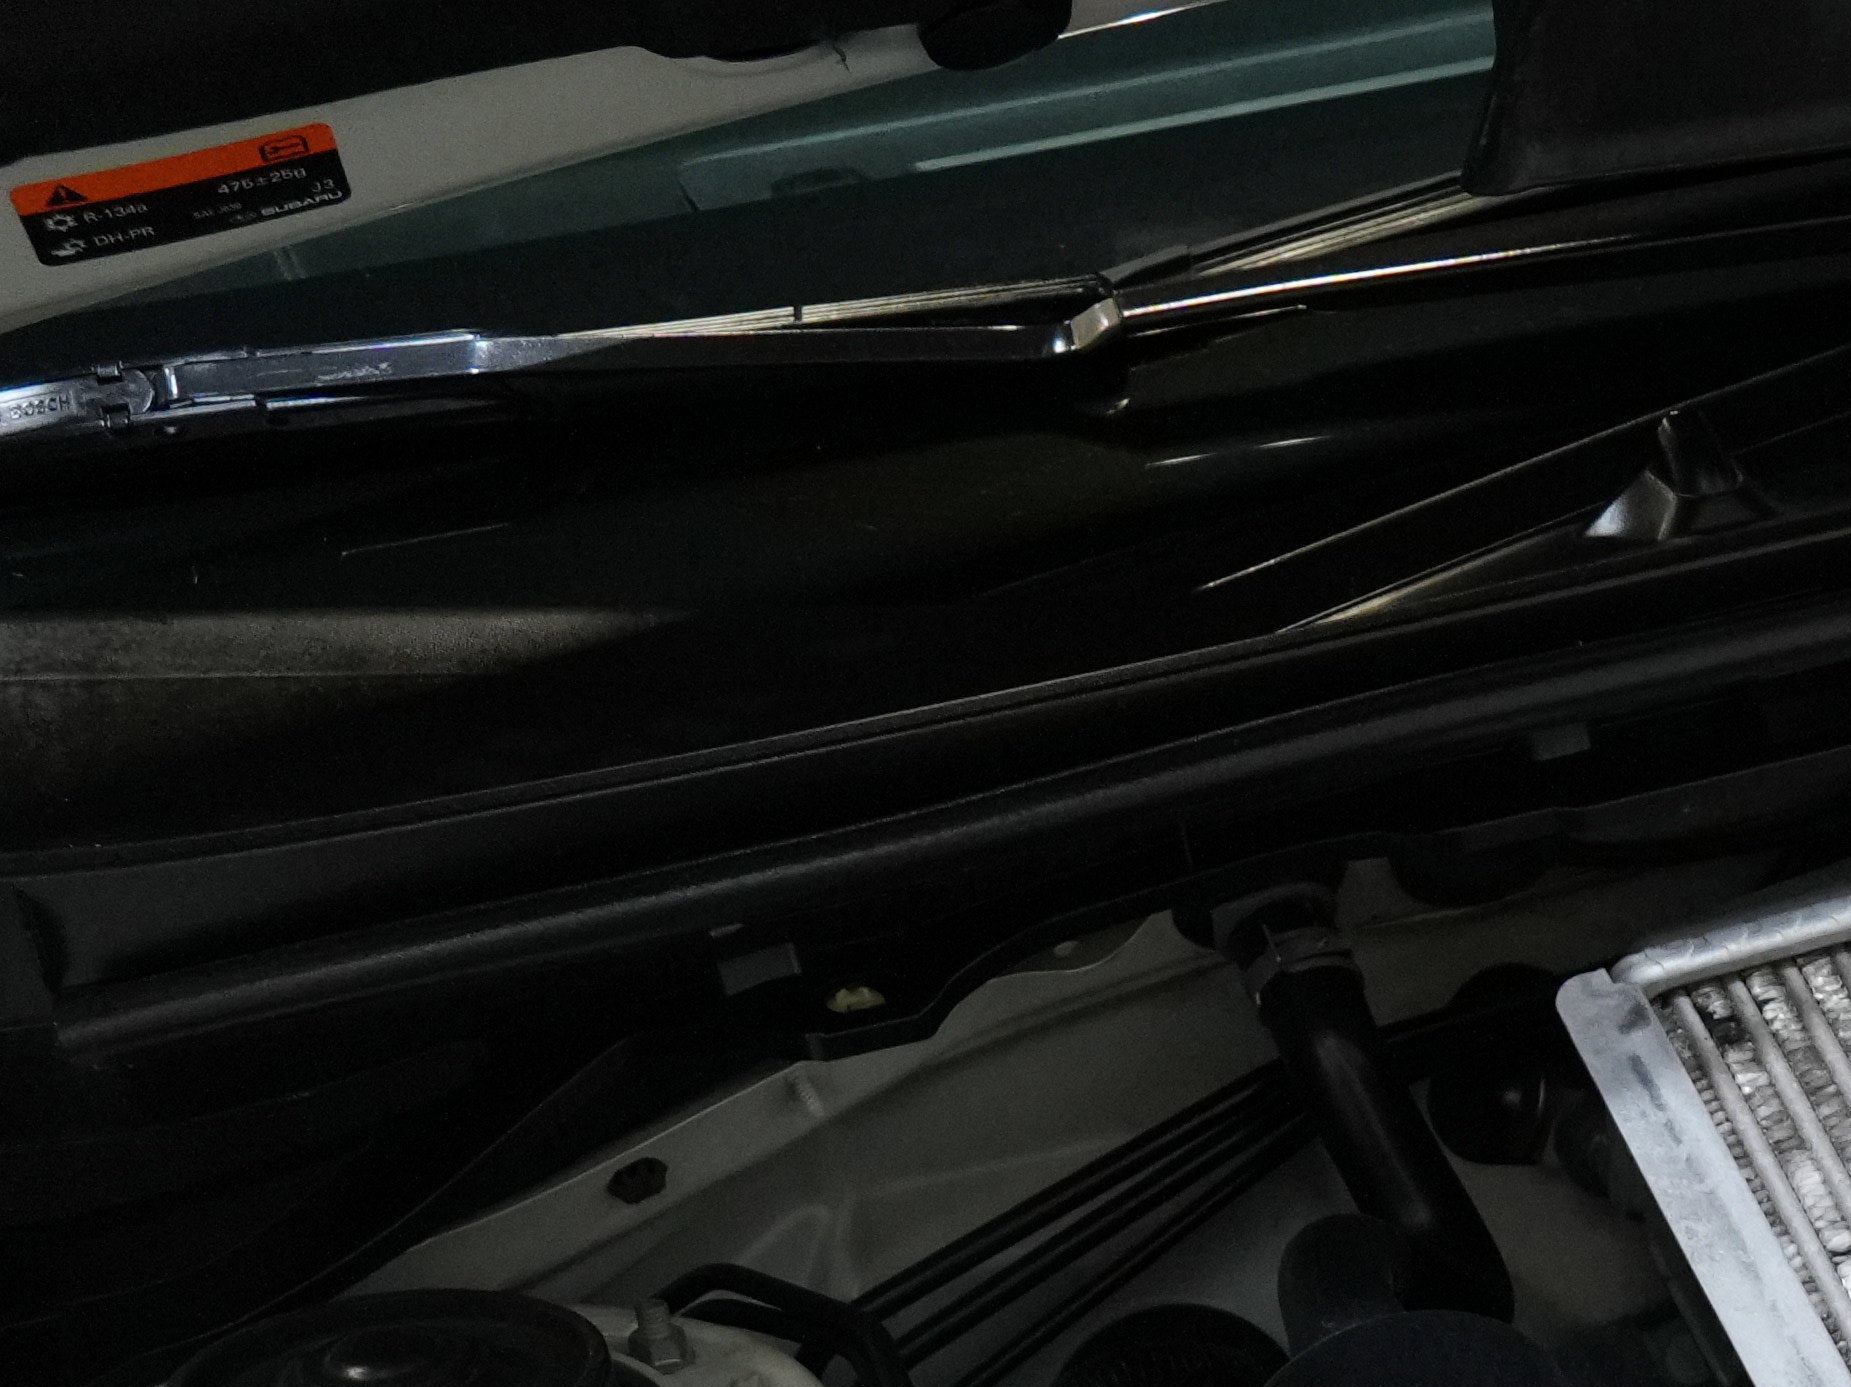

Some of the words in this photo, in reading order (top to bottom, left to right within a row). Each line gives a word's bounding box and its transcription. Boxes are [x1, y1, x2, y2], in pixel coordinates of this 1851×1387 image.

[83, 203, 148, 223] R-134a
[261, 190, 343, 216] SUBARU
[9, 394, 71, 420] BOSCH
